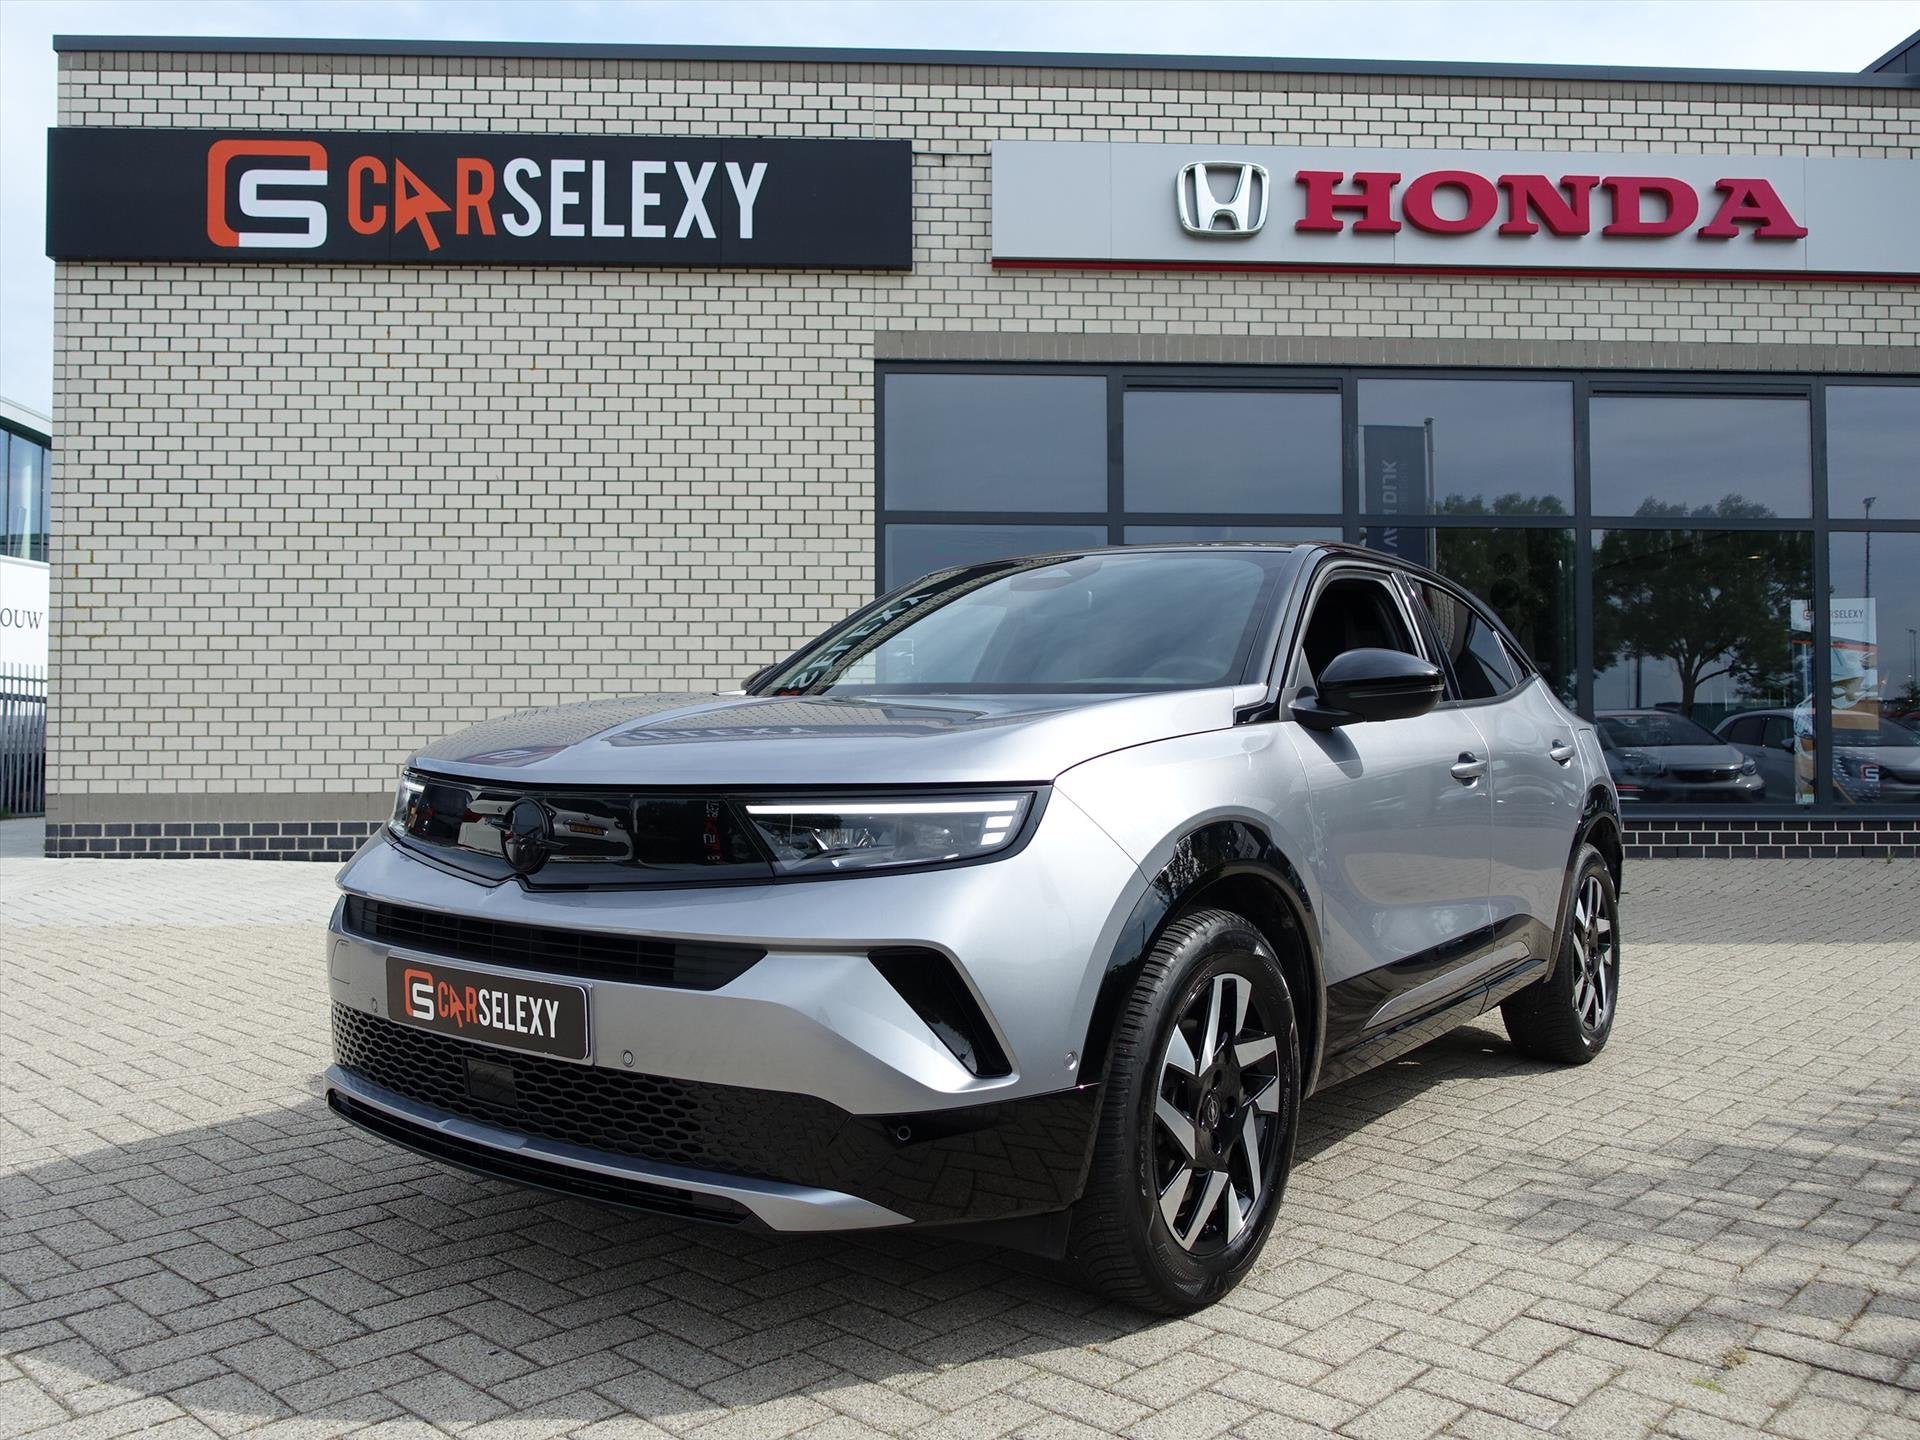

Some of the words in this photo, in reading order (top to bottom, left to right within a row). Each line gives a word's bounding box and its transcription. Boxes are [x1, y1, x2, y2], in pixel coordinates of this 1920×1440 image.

[347, 155, 768, 251] CARSELEXY
[1295, 170, 1809, 239] HONDA
[437, 981, 559, 1039] CARSELEXY
